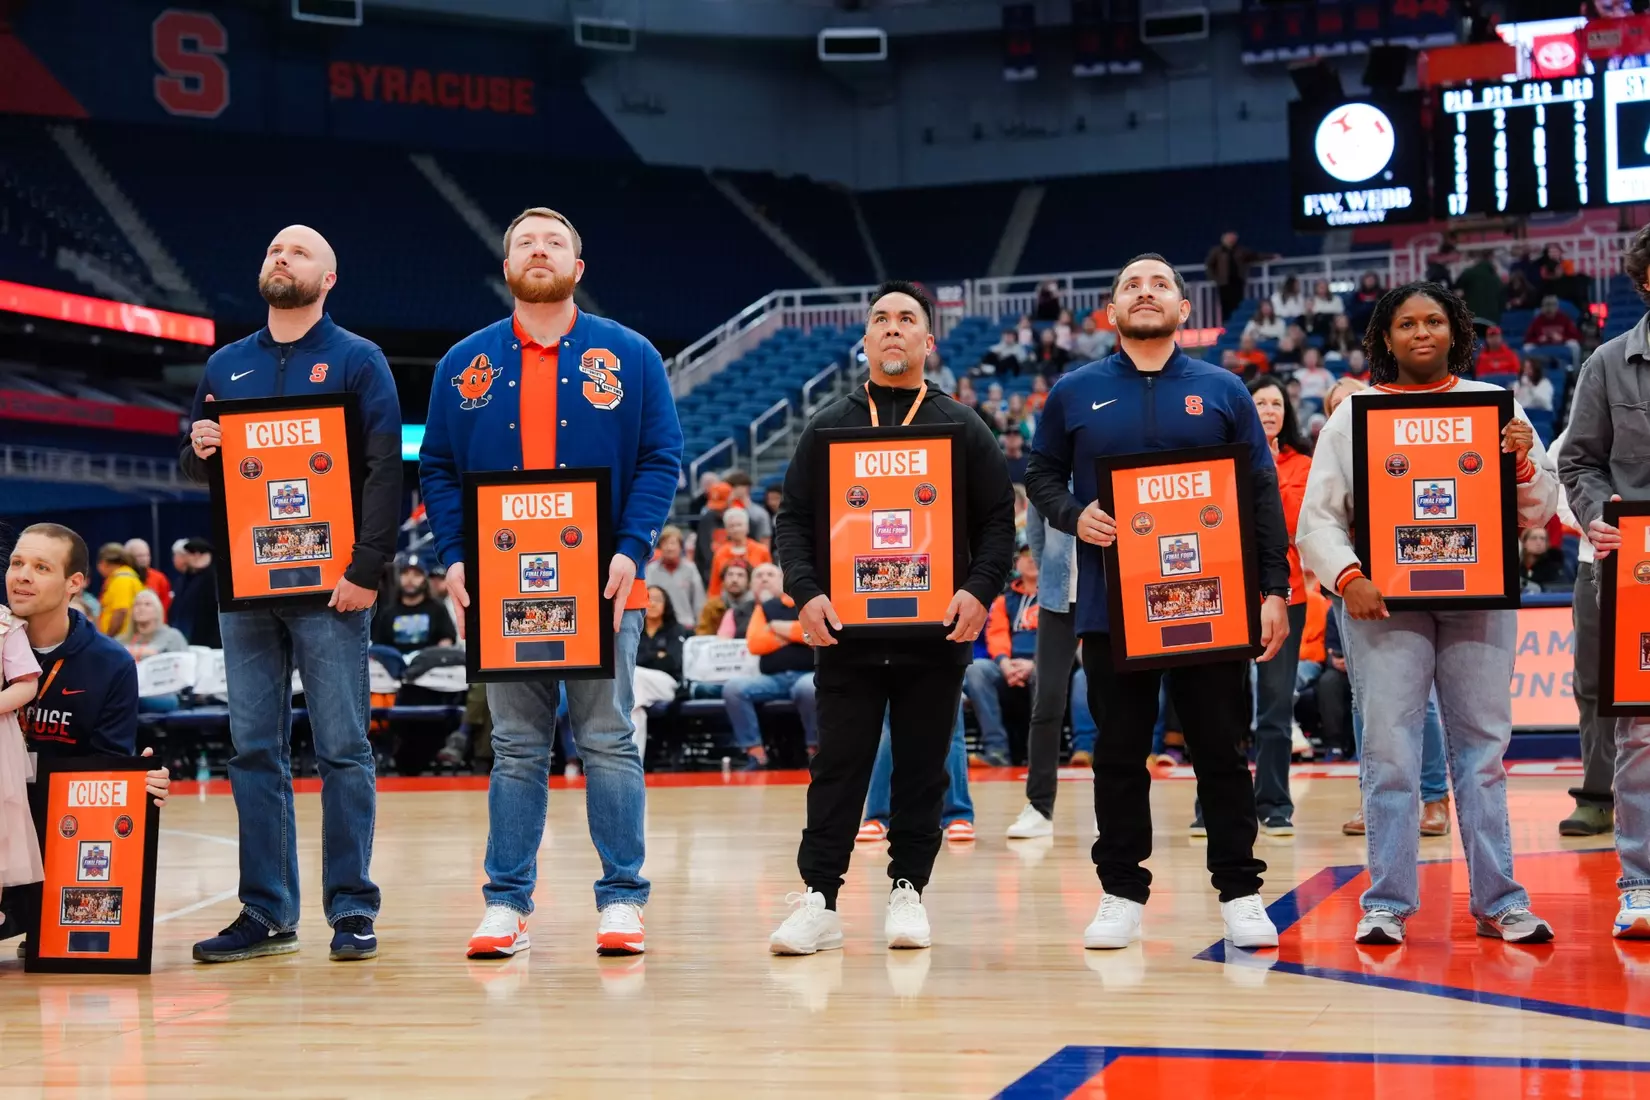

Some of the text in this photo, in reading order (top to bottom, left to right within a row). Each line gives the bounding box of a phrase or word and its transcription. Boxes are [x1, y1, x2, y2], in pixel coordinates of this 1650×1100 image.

[153, 9, 230, 119] S
[329, 60, 536, 116] SYRACUSE
[1345, 186, 1412, 211] WEBB
[1448, 194, 1468, 215] 17
[1496, 189, 1508, 211] 7
[309, 363, 329, 383] S
[1185, 395, 1204, 415] S
[248, 420, 315, 446] 'CUSE
[1397, 418, 1467, 443] 'CUSE
[858, 450, 921, 476] 'CUSE
[1140, 472, 1205, 501] 'CUSE
[505, 493, 567, 519] 'CUSE
[1180, 551, 1194, 559] FOUR
[71, 781, 122, 806] 'CUSE
